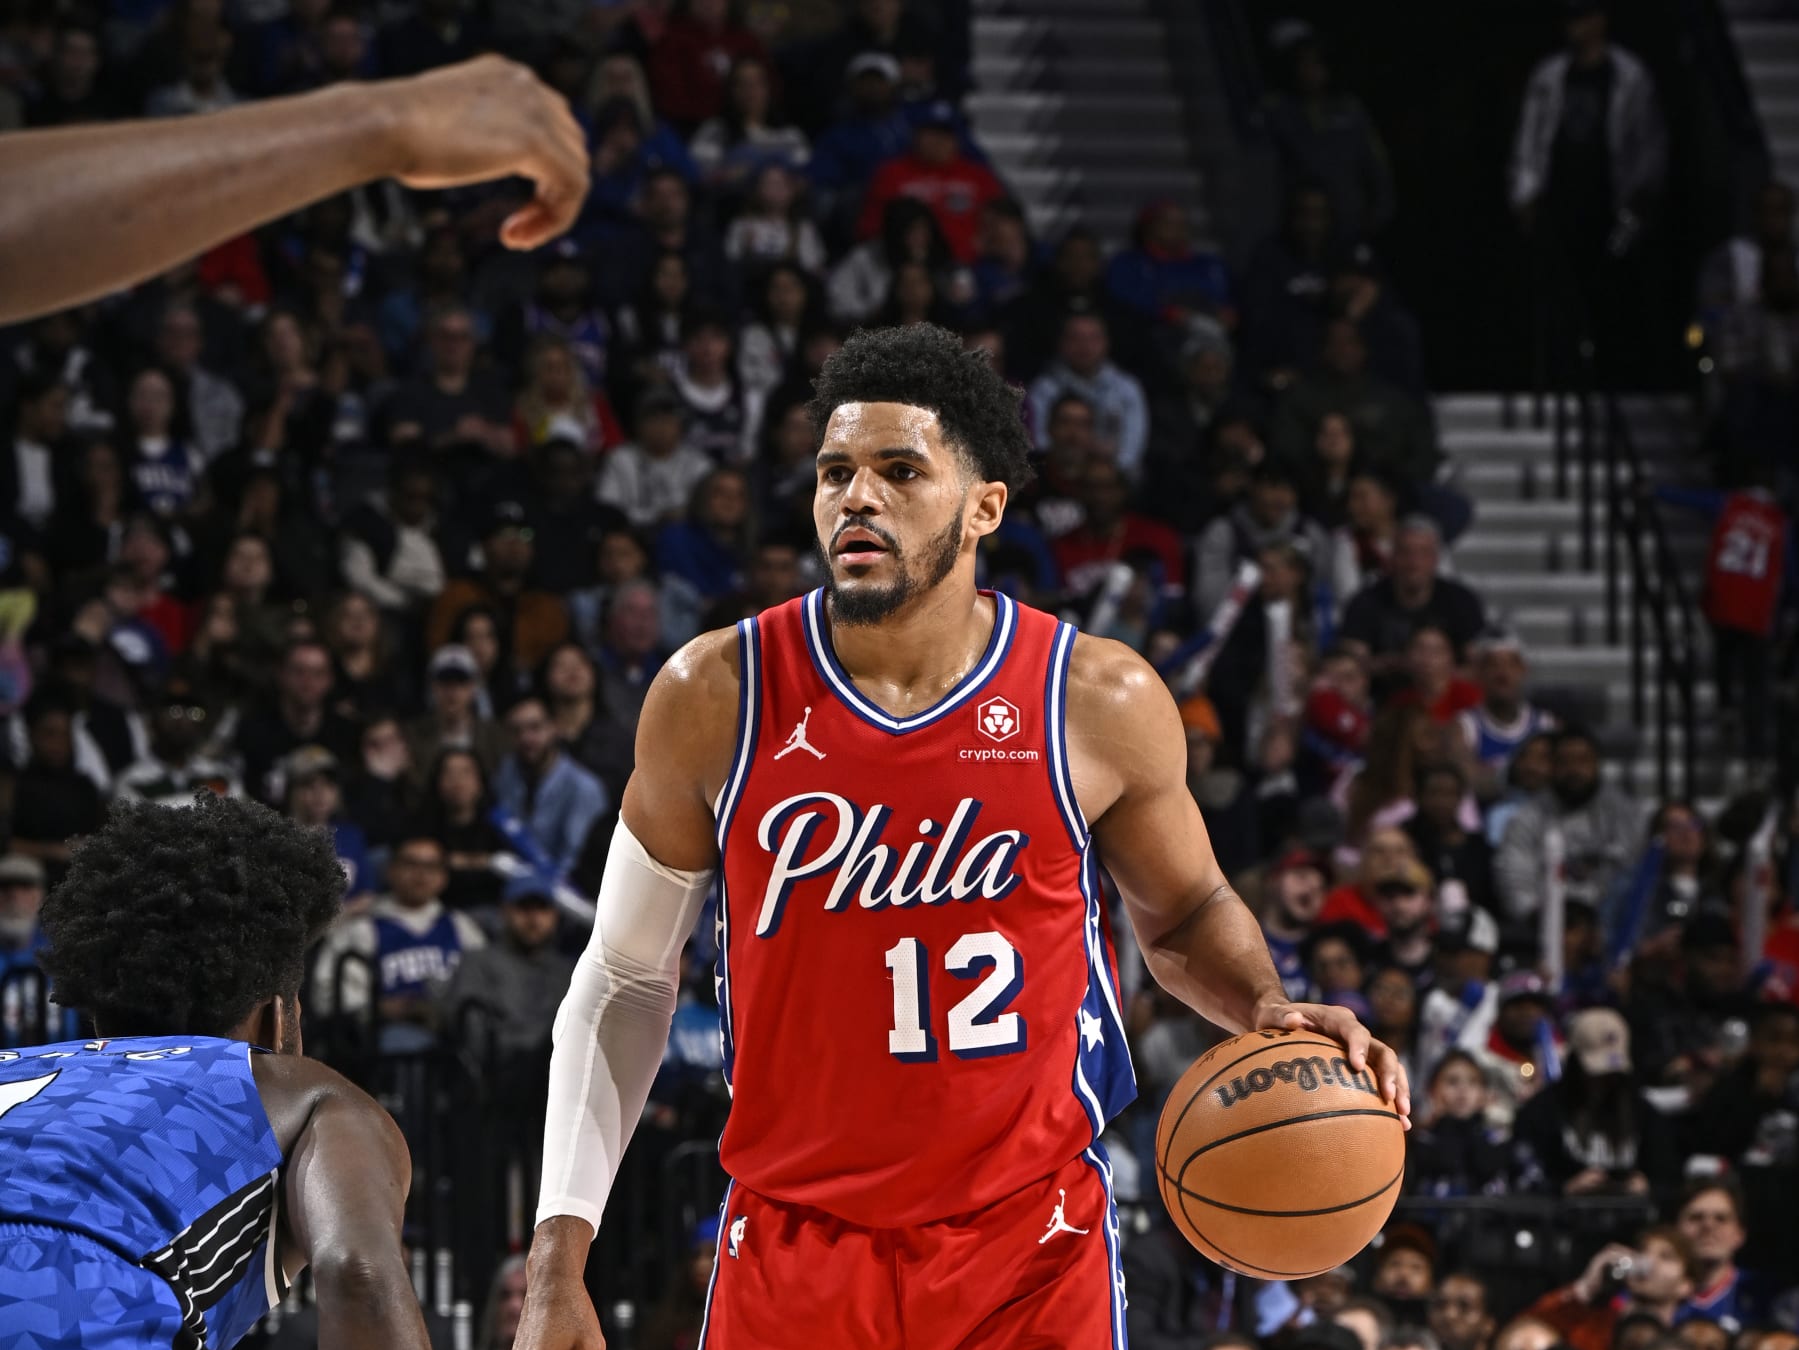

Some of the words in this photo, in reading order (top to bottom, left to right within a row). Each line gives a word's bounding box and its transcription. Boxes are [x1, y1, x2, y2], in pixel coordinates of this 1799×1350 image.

[959, 747, 1039, 761] crypto.com
[755, 791, 1030, 939] Phila
[885, 931, 1027, 1063] 12
[1216, 1056, 1379, 1107] Wilson
